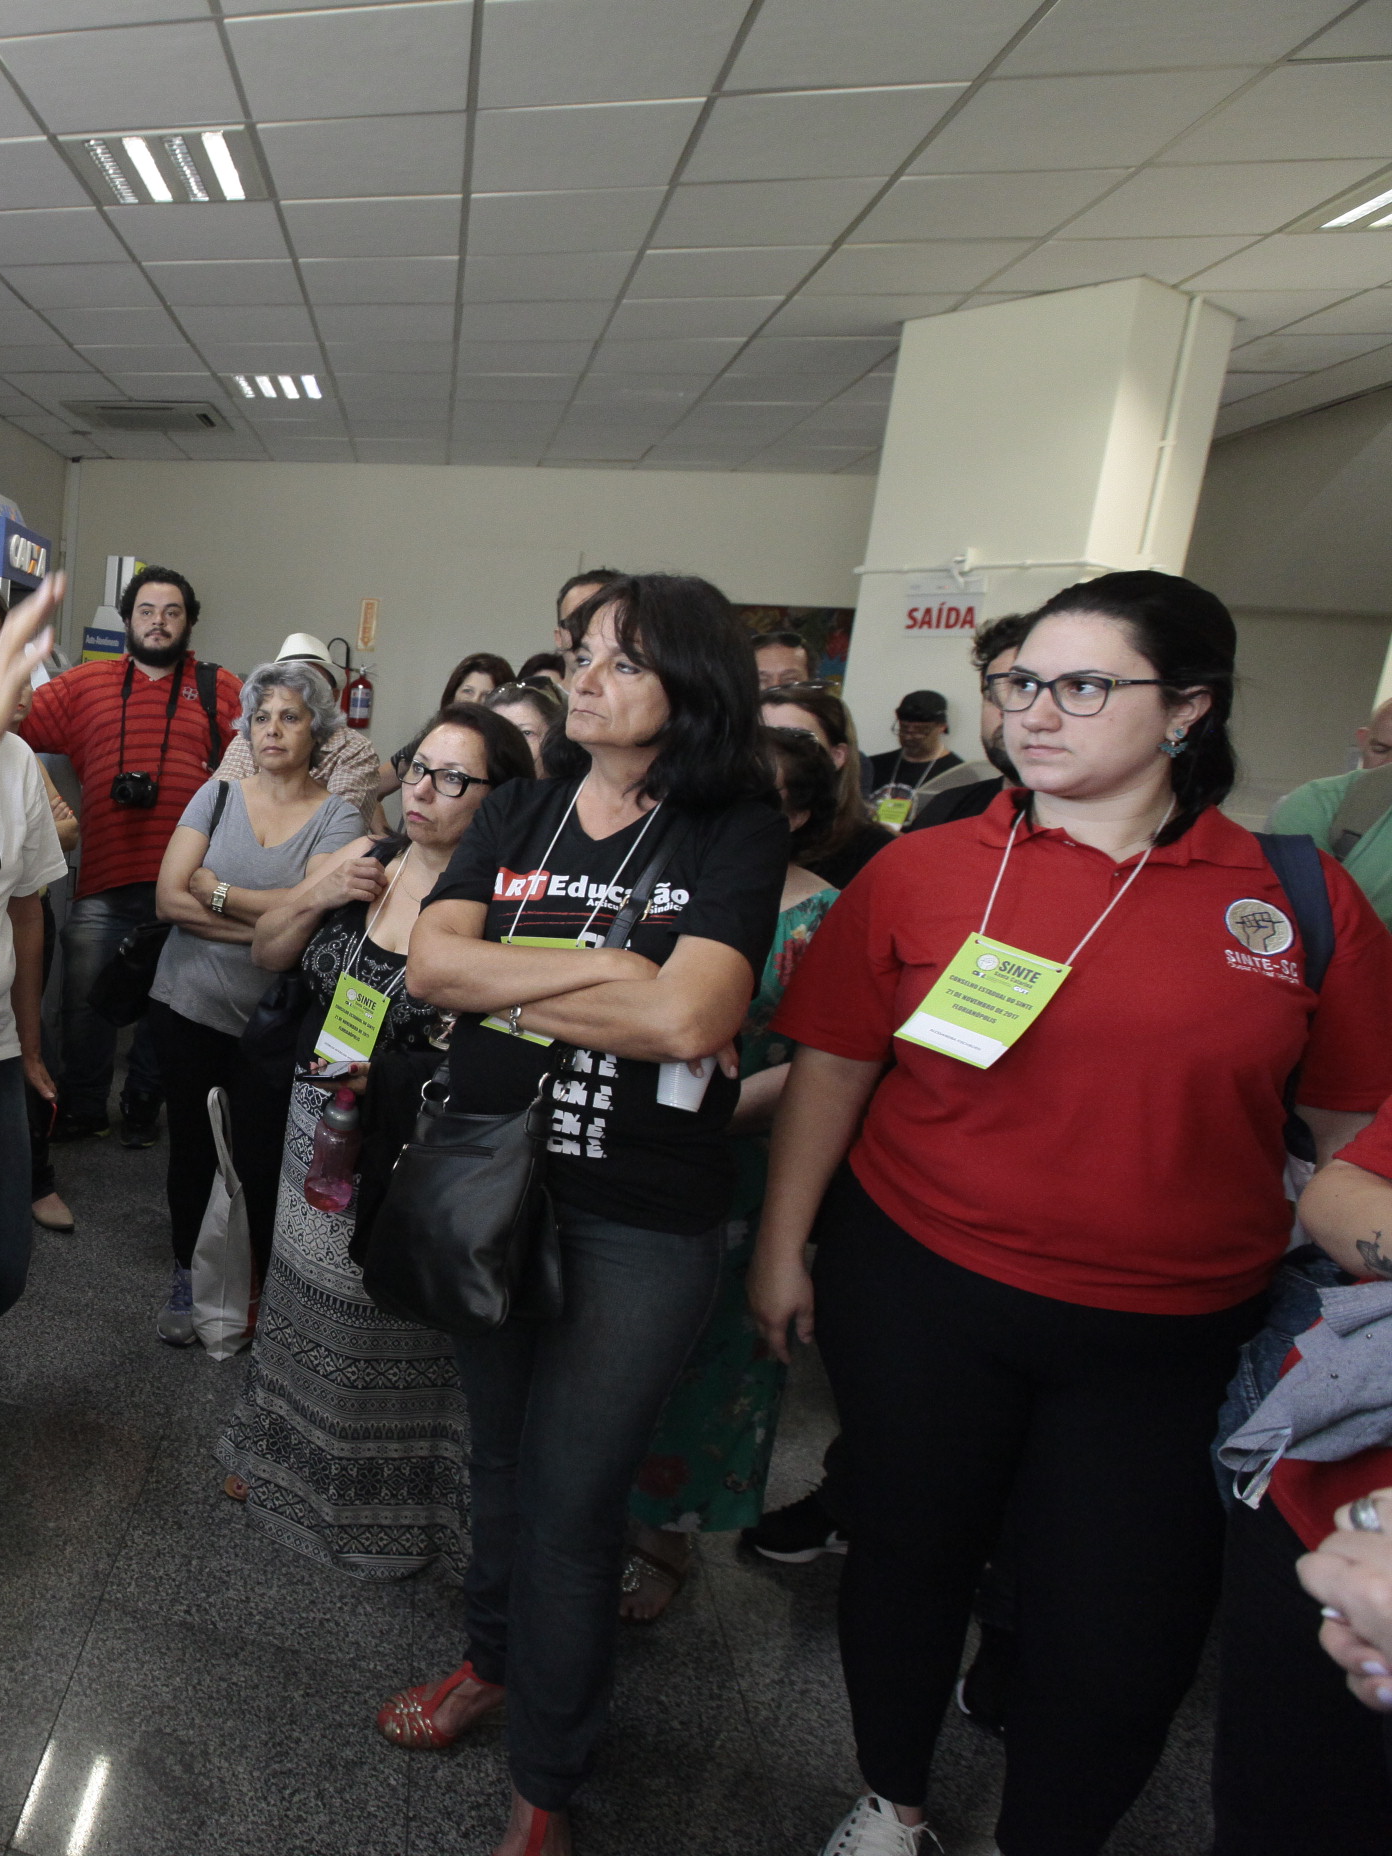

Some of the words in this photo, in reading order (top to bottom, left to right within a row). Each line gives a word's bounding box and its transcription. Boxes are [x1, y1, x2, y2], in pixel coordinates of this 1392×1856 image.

[9, 534, 47, 580] CAIXA
[905, 601, 976, 630] SAÍDA
[547, 874, 690, 905] Educão
[998, 960, 1042, 984] SINTE
[1224, 949, 1298, 977] SINTE-SC
[356, 993, 377, 1011] SINTE
